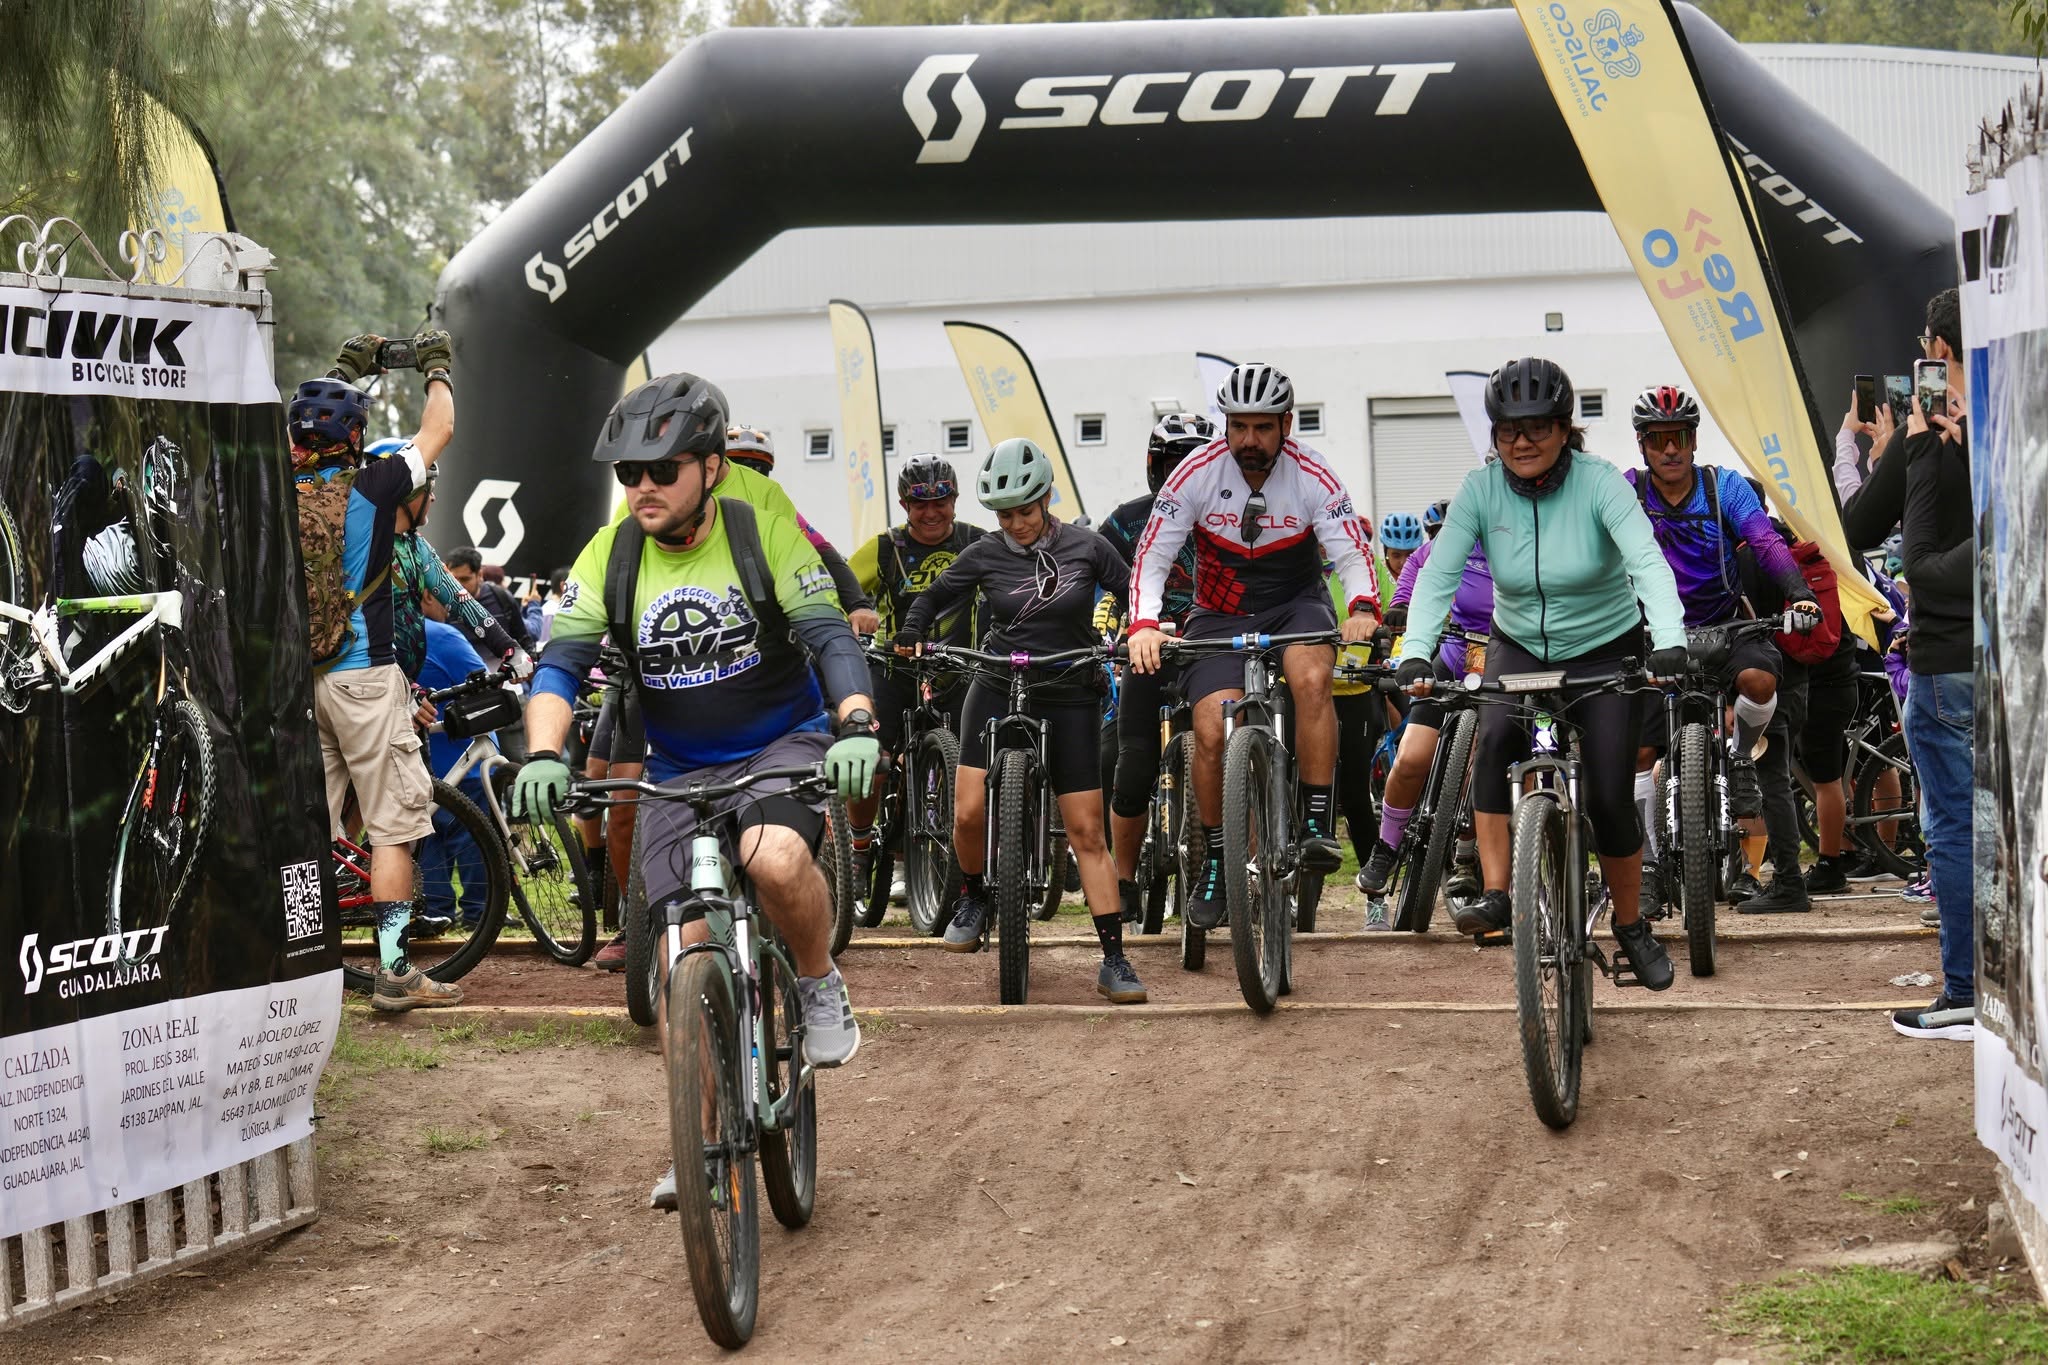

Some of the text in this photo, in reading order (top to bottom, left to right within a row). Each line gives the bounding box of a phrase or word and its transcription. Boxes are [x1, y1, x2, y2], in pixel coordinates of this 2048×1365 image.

[1000, 62, 1456, 129] SCOTT
[564, 126, 694, 270] SCOTT
[72, 362, 187, 388] BICYCLE STORE
[1206, 513, 1298, 529] ORCLE
[46, 925, 169, 974] SCOTT
[59, 962, 161, 999] GUADALAJARA
[268, 998, 297, 1019] SUR
[122, 1024, 162, 1051] ZONA
[239, 1036, 255, 1050] AV.
[294, 1021, 321, 1039] LÓPEZ
[5, 1046, 70, 1079] CALZADA
[175, 1047, 199, 1065] 3841,
[263, 1051, 282, 1067] SUR
[17, 1074, 85, 1104] INDEPENDENCIA
[121, 1082, 160, 1104] JARDINES
[223, 1085, 237, 1100] 8-A
[241, 1082, 248, 1095] Y
[265, 1076, 274, 1088] EL
[221, 1105, 244, 1123] 45643
[297, 1083, 308, 1098] DE
[14, 1106, 68, 1132] NORTE 1324,
[120, 1112, 146, 1130] 45138
[68, 1126, 91, 1145] 44340
[4, 1161, 68, 1190] GUADALAJARA,
